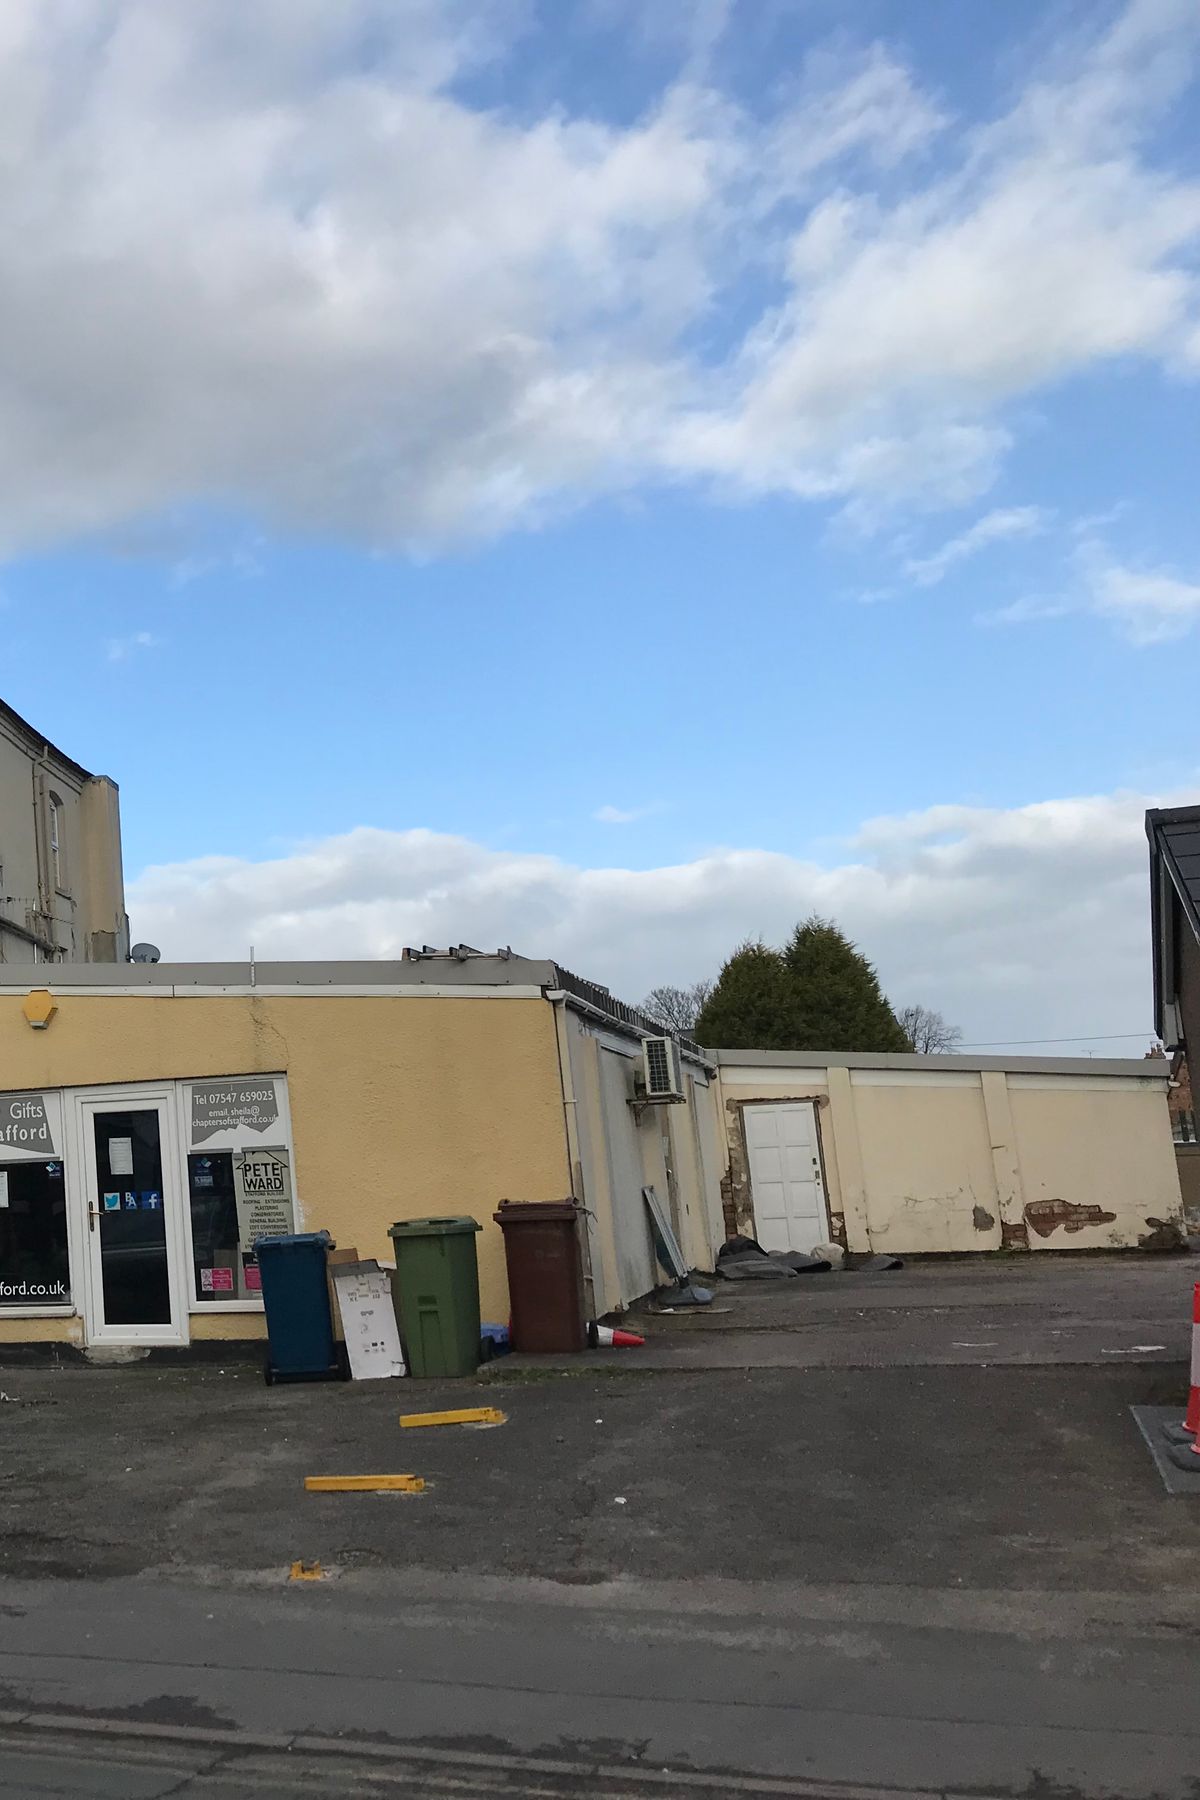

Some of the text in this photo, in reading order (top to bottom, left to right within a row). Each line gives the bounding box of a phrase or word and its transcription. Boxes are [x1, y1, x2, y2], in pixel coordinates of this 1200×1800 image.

[193, 1090, 274, 1105] Tel 07547 659025
[9, 1101, 43, 1119] Gifts
[244, 1162, 281, 1177] PETE
[245, 1177, 282, 1190] WARD
